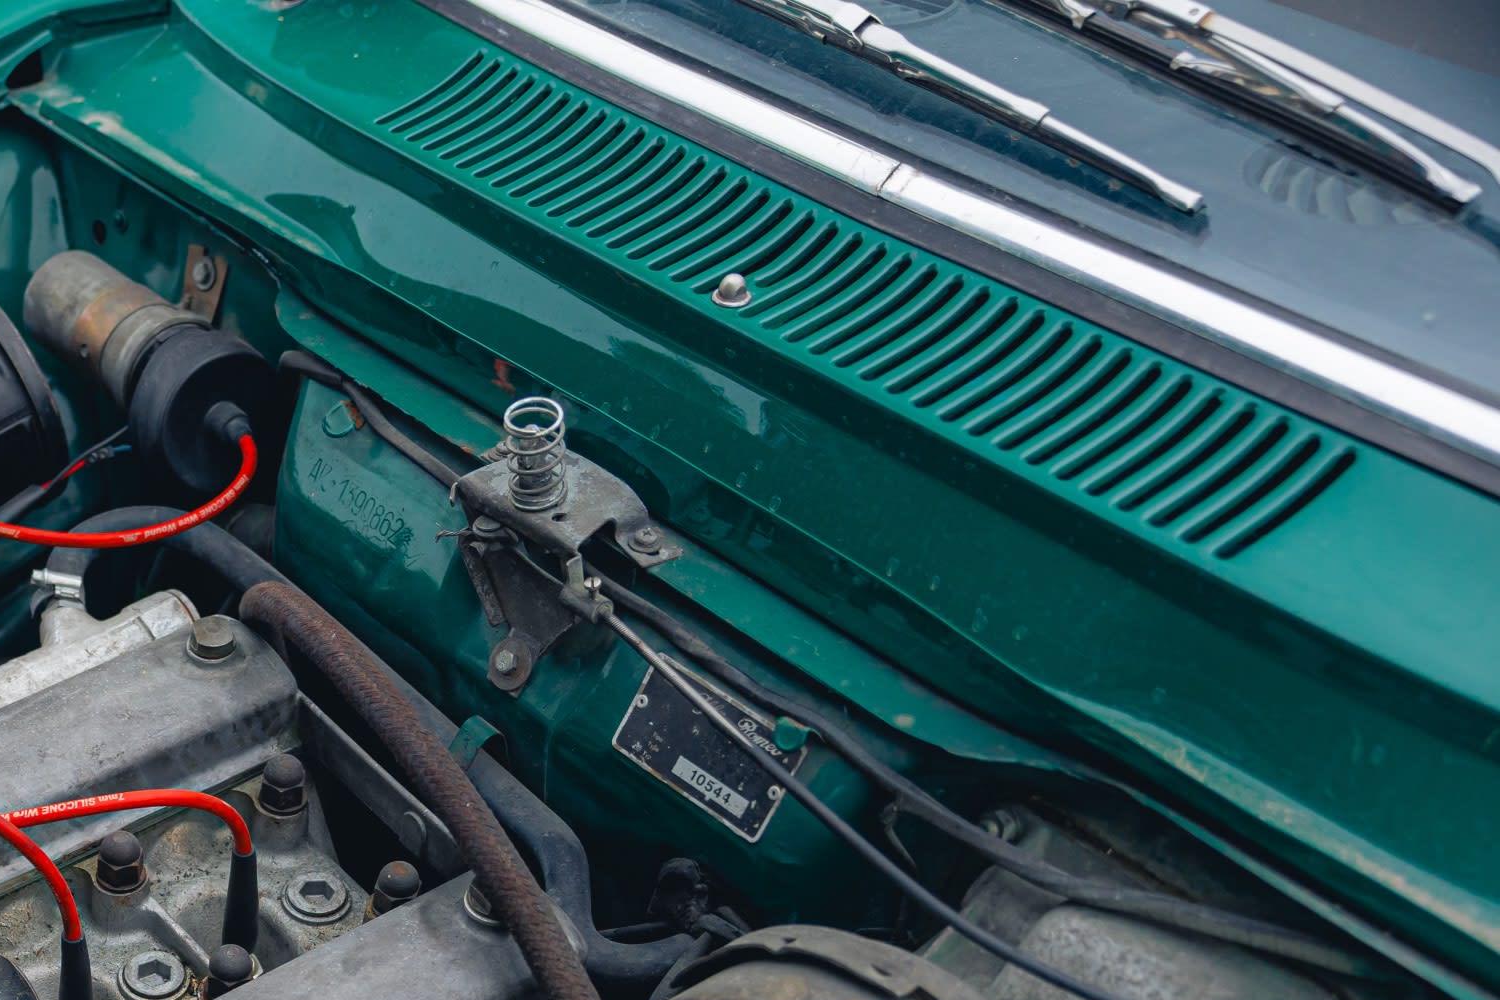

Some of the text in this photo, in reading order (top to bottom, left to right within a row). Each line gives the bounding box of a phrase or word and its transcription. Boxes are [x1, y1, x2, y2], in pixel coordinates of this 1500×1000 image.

[144, 521, 177, 539] Wound
[178, 514, 199, 527] Wire
[738, 718, 783, 757] Romeo
[690, 769, 731, 804] 10544
[13, 792, 125, 818] 7mm SILICONE Wire
